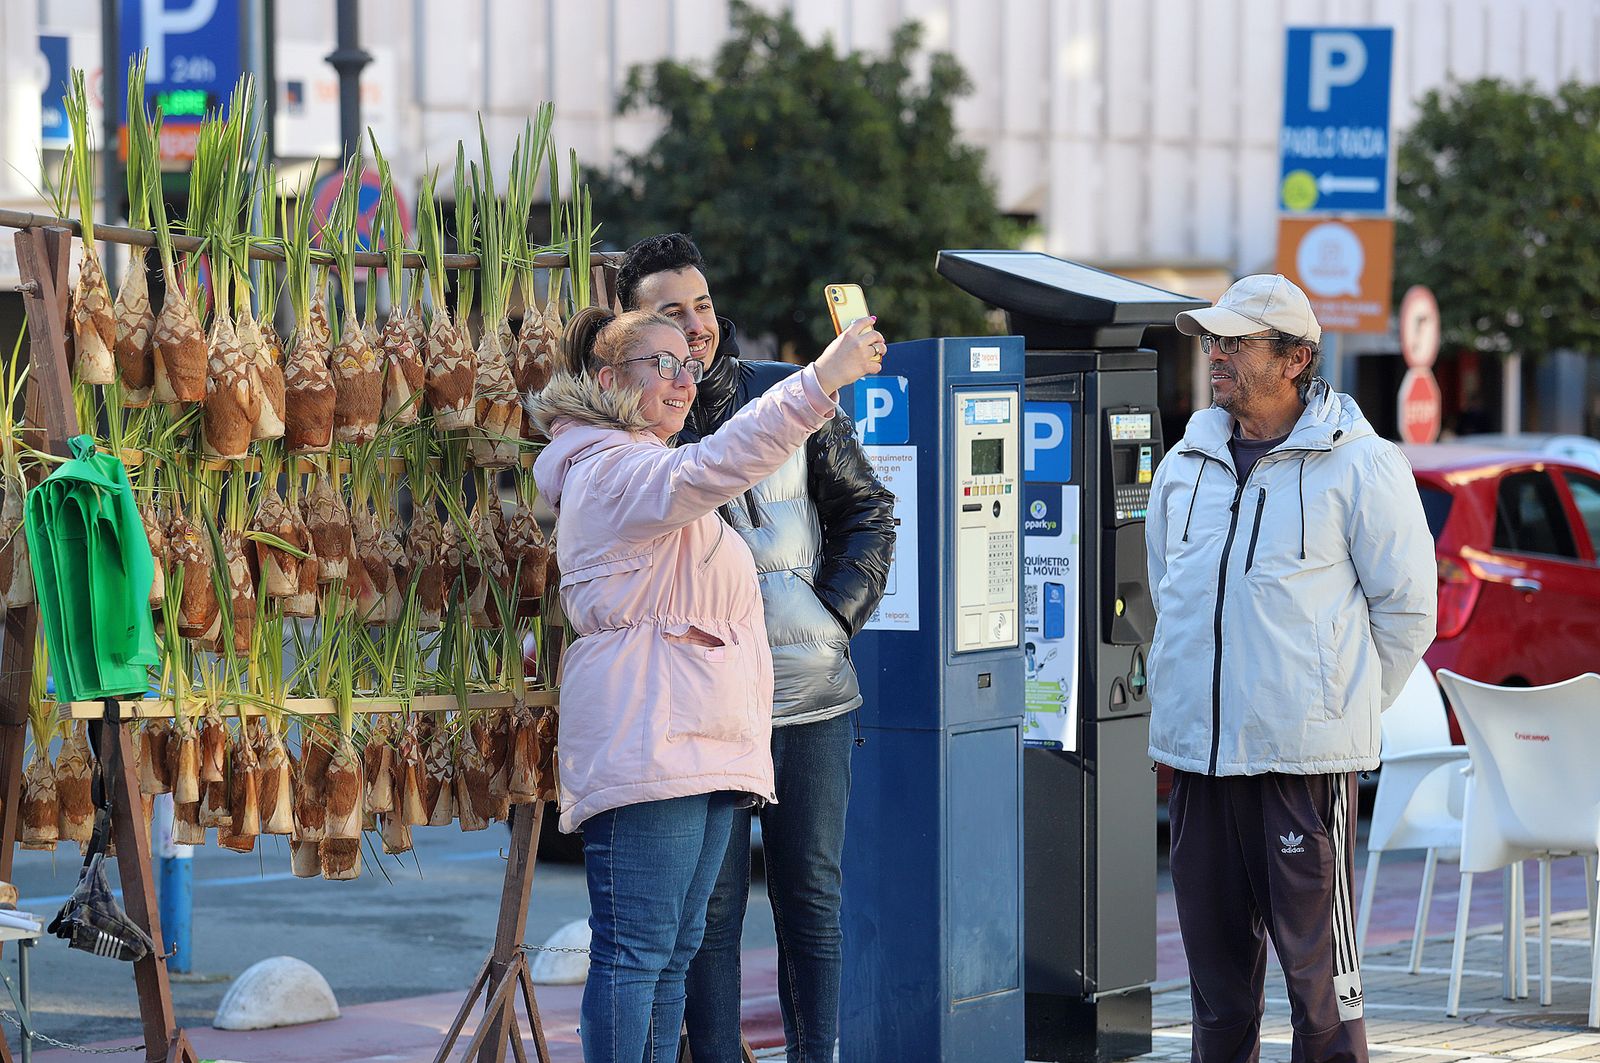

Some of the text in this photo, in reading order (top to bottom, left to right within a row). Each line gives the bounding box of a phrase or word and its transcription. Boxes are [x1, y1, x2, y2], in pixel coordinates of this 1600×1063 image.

[141, 0, 217, 83] P
[1308, 31, 1368, 112] P
[866, 388, 894, 433] P
[1024, 411, 1064, 471] P
[1033, 565, 1062, 576] MÓVIL
